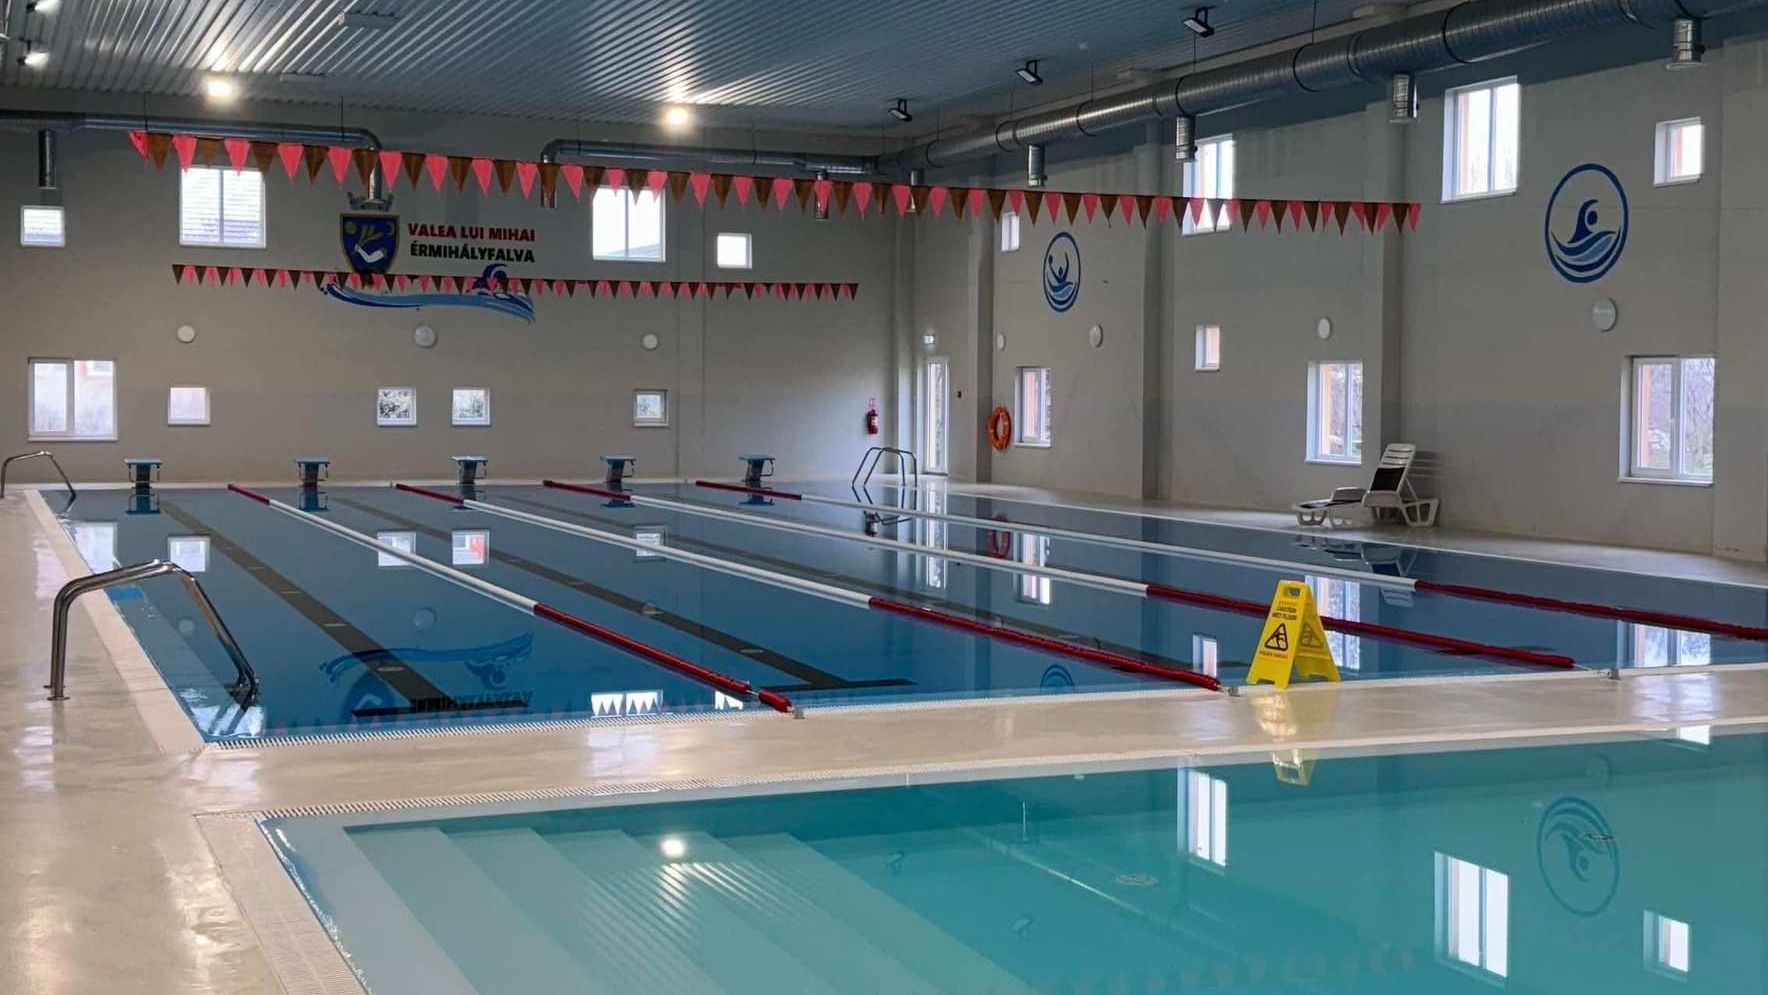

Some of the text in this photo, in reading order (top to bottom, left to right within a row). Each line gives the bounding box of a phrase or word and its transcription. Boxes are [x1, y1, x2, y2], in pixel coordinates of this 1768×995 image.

[408, 223, 535, 241] VALEA LUI MIHAI
[410, 240, 535, 263] ÉRMIHÁLYFALVA
